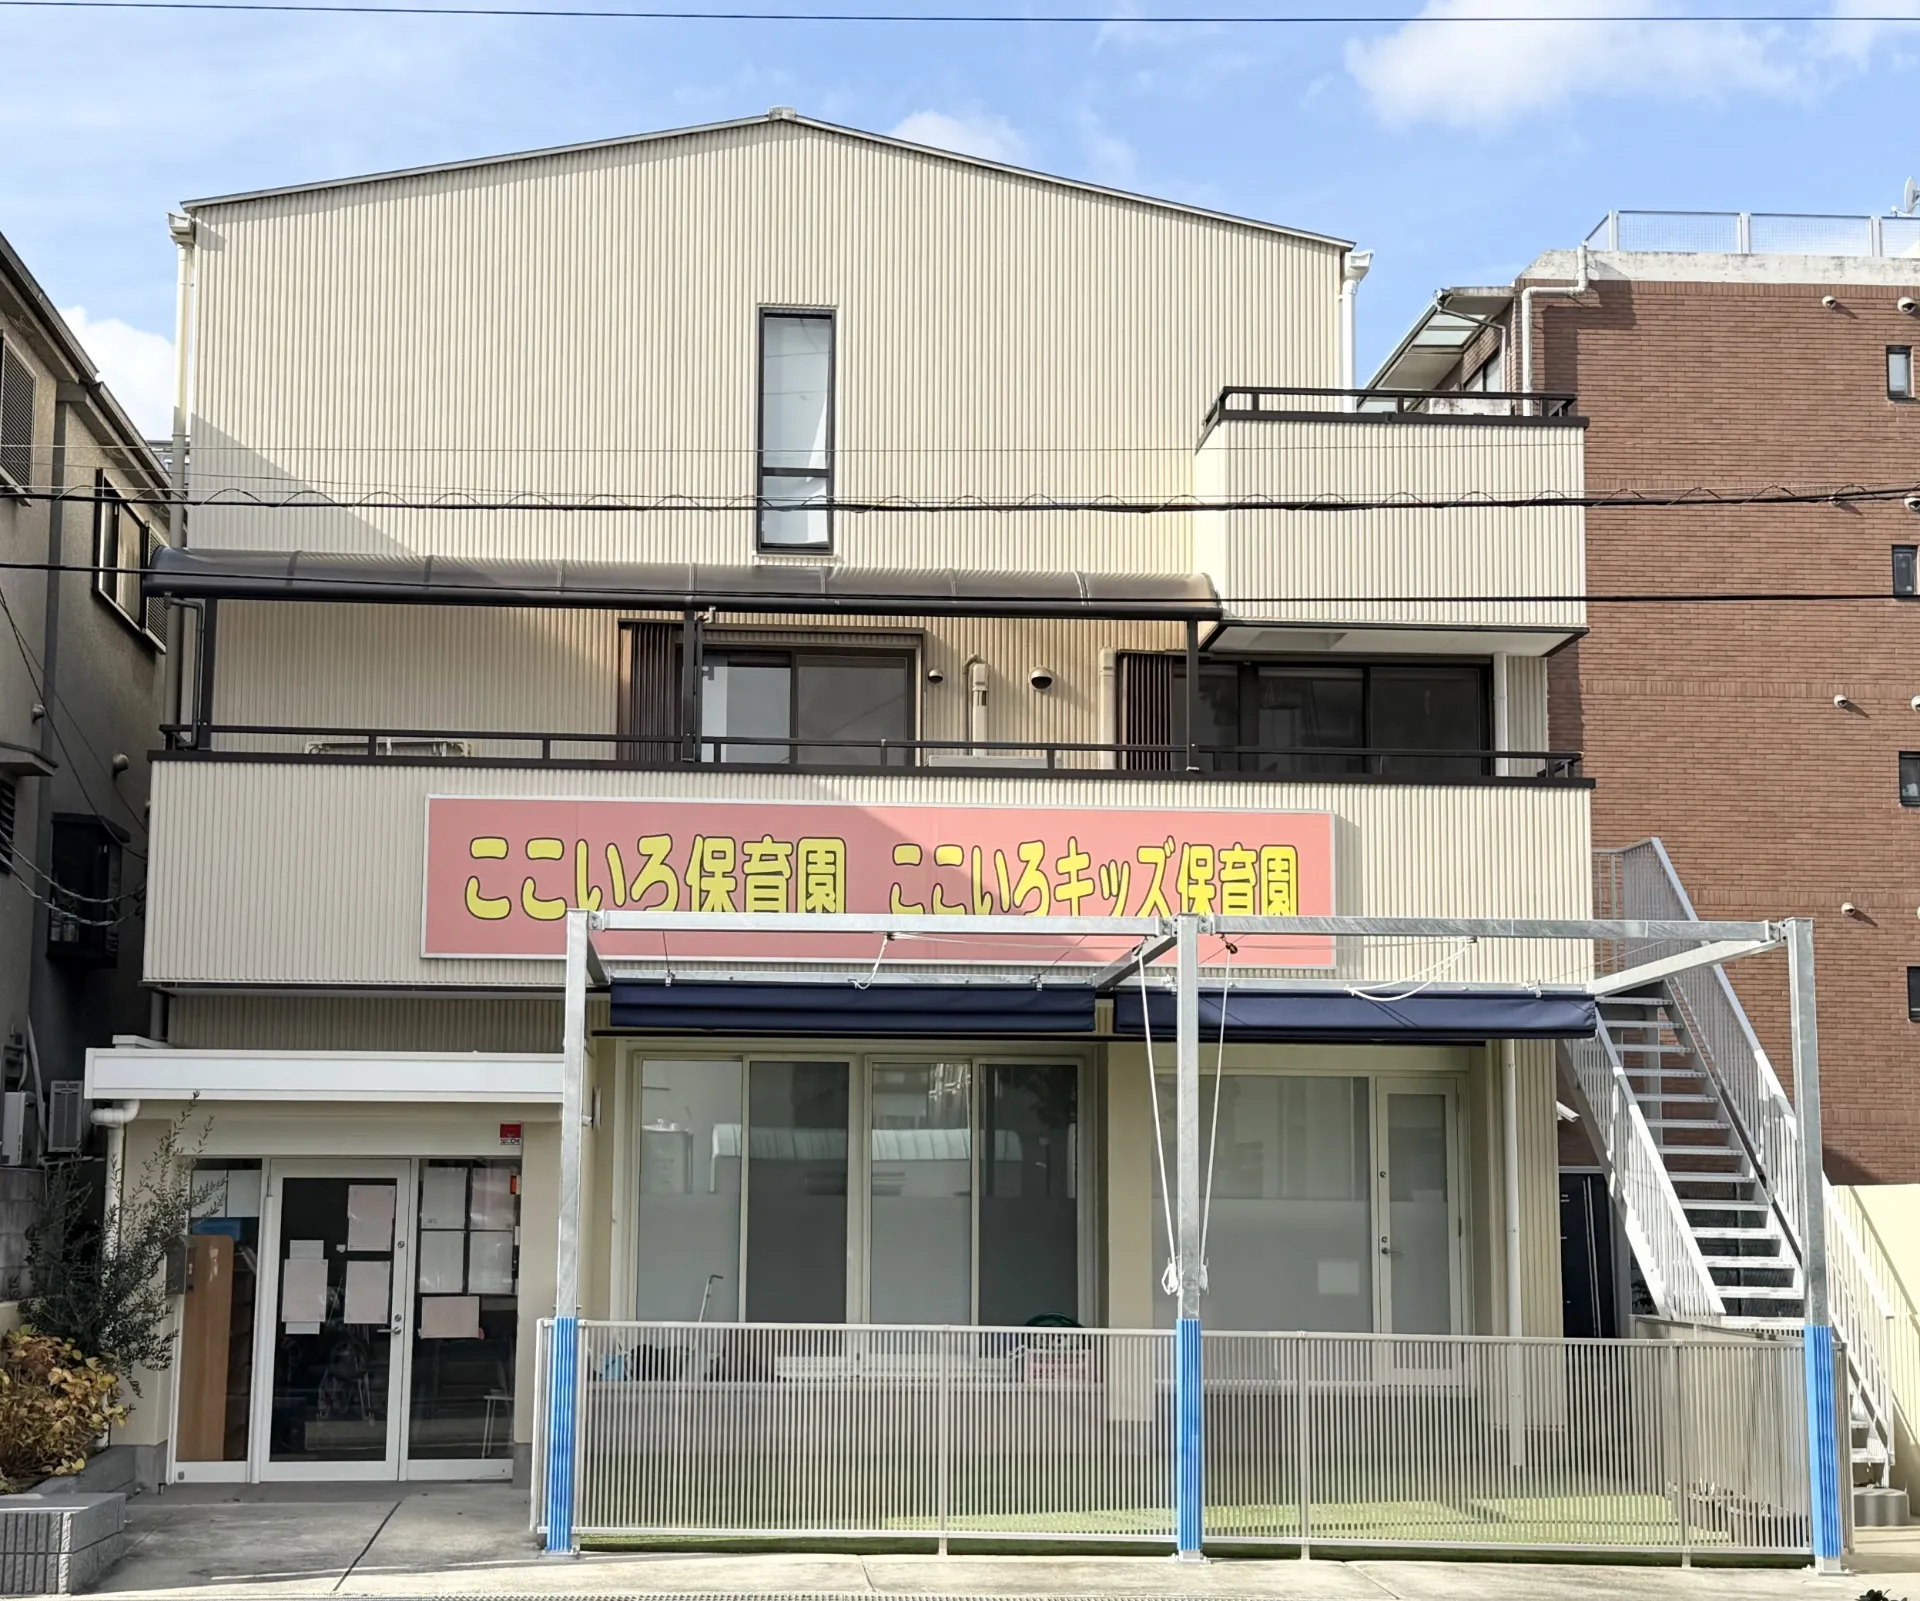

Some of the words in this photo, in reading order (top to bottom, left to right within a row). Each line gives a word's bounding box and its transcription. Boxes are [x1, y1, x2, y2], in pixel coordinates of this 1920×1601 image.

[465, 834, 846, 920] ここいろ保育園
[890, 836, 1298, 916] ここいろキッズ保育園
